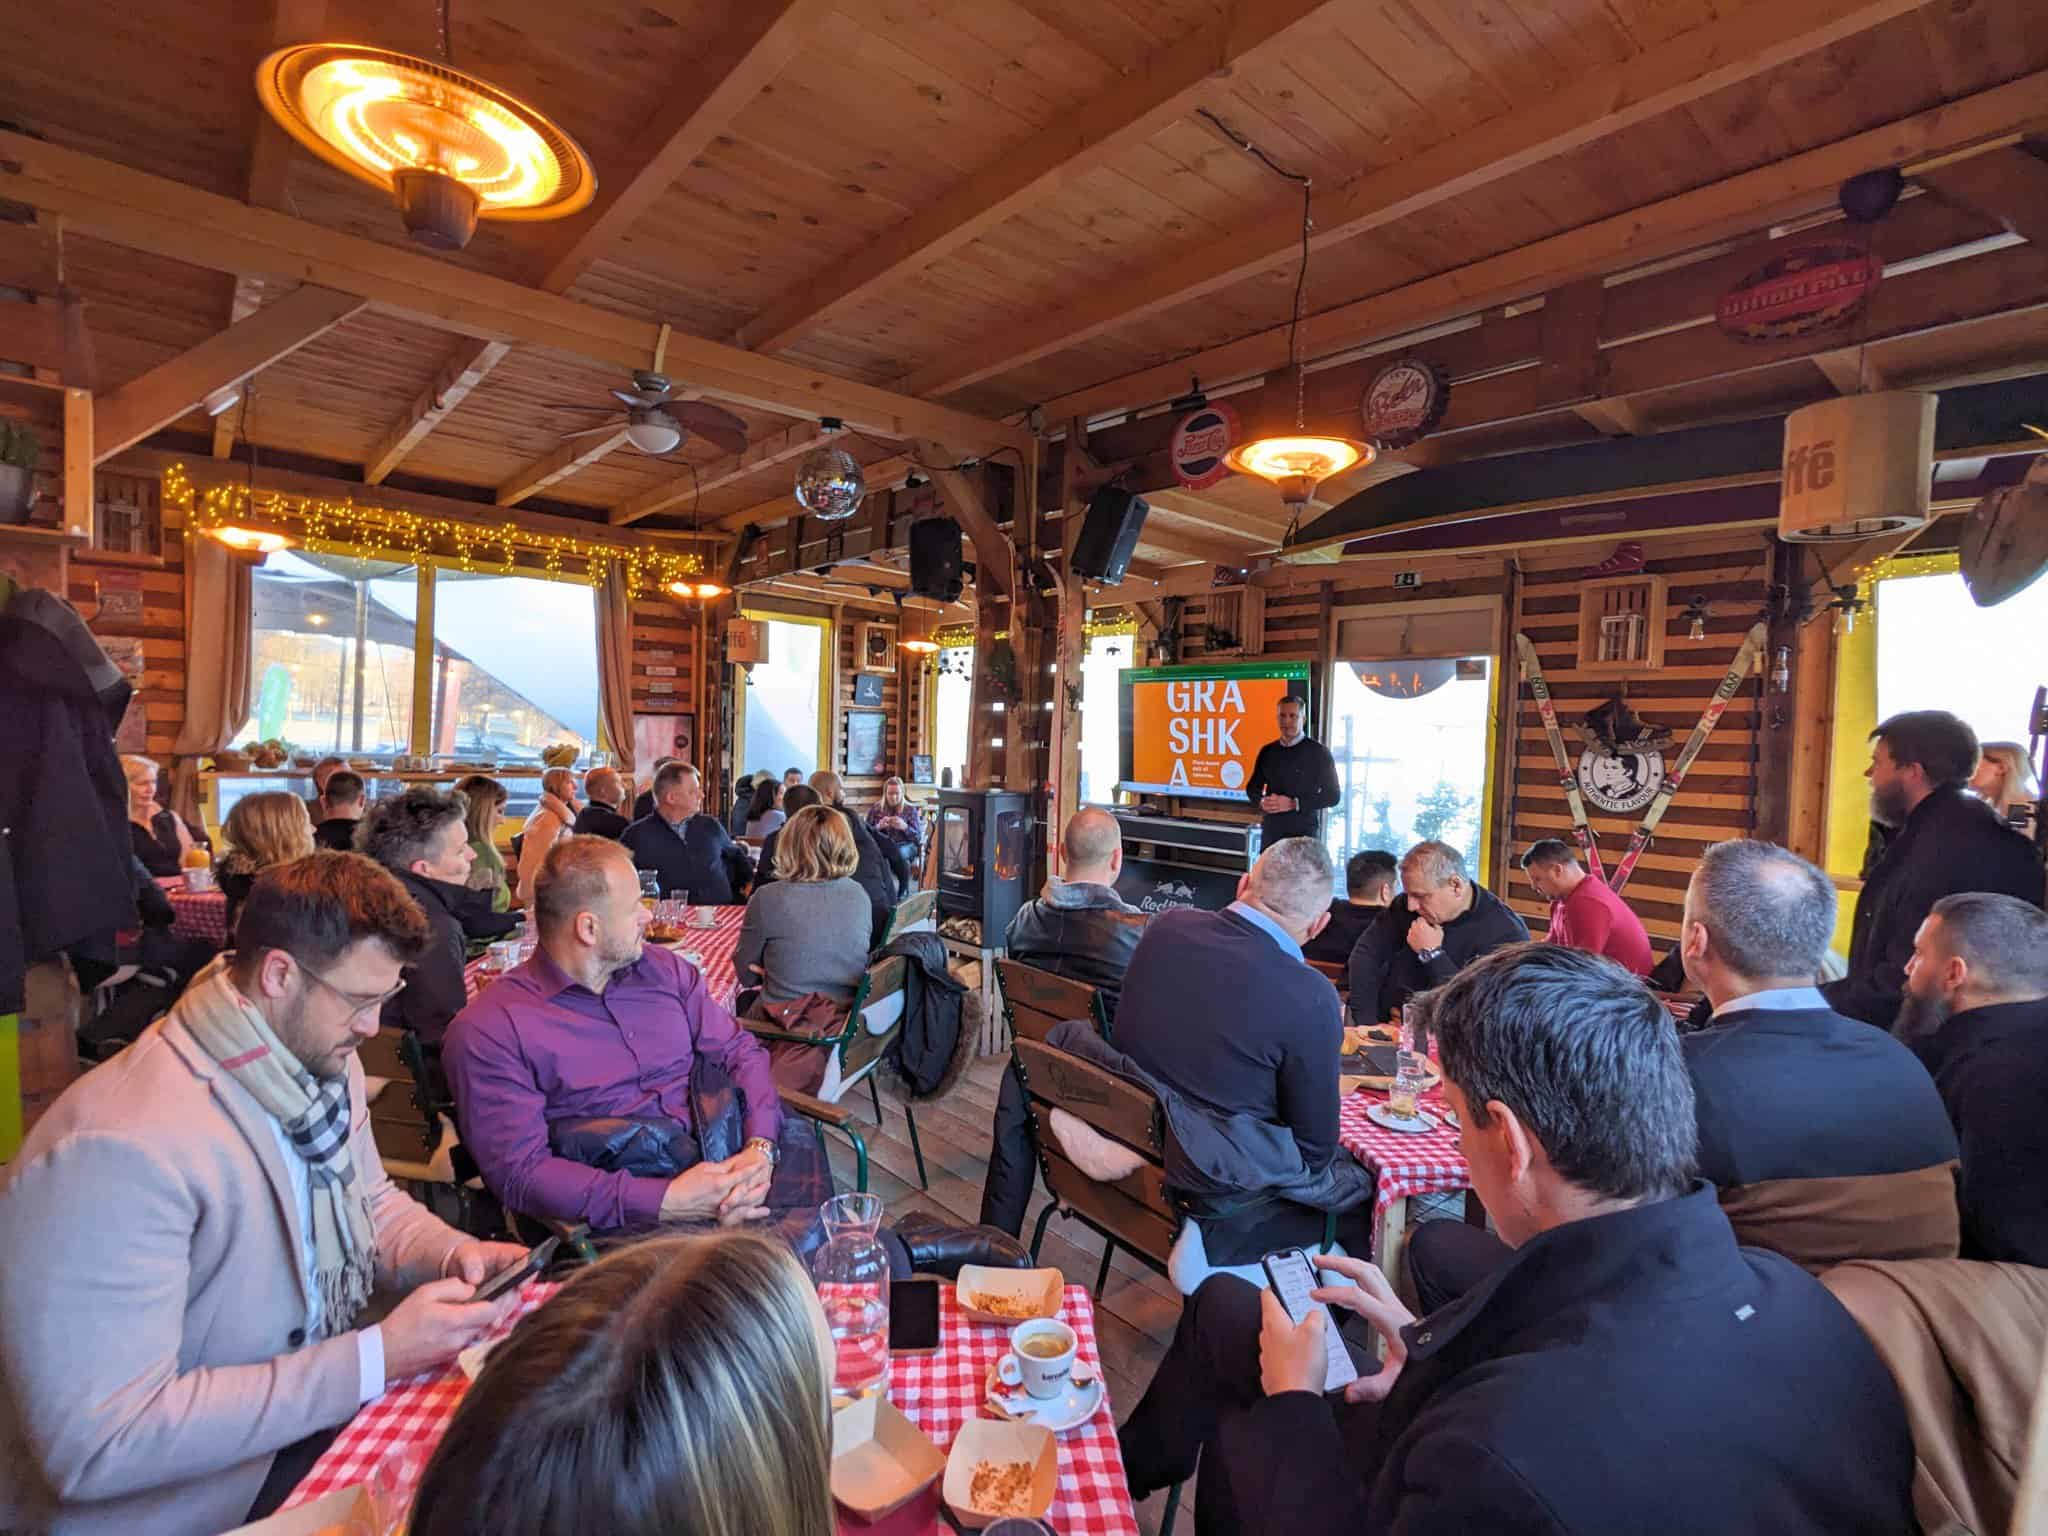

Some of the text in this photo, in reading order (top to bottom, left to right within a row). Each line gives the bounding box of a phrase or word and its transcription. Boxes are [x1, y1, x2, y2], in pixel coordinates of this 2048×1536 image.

[1167, 680, 1246, 713] GRA
[1168, 717, 1242, 755] SHK
[1170, 758, 1190, 787] A
